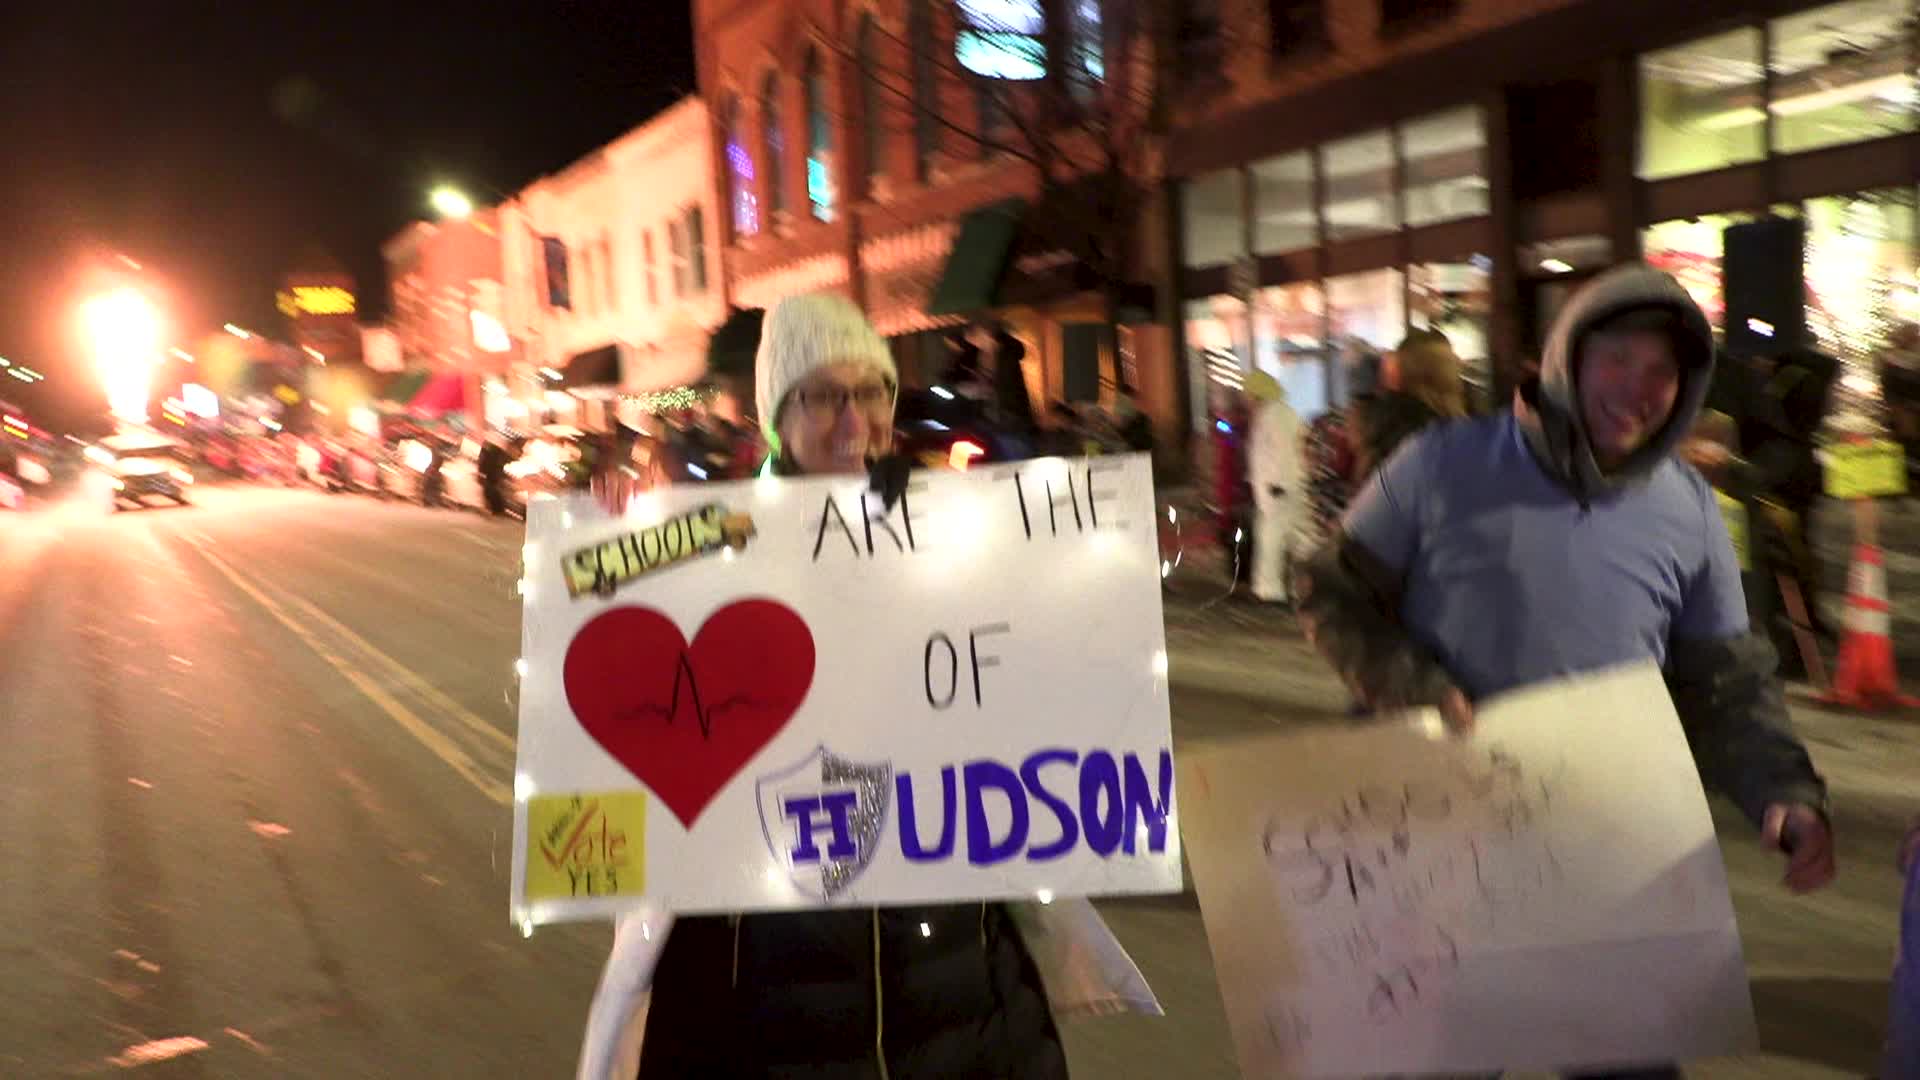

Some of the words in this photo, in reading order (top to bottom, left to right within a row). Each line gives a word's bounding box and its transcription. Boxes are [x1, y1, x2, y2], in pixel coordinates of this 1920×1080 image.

[572, 504, 726, 592] SCHOOLS
[992, 464, 1130, 541] THE
[924, 622, 1010, 711] OF
[567, 866, 619, 897] YES
